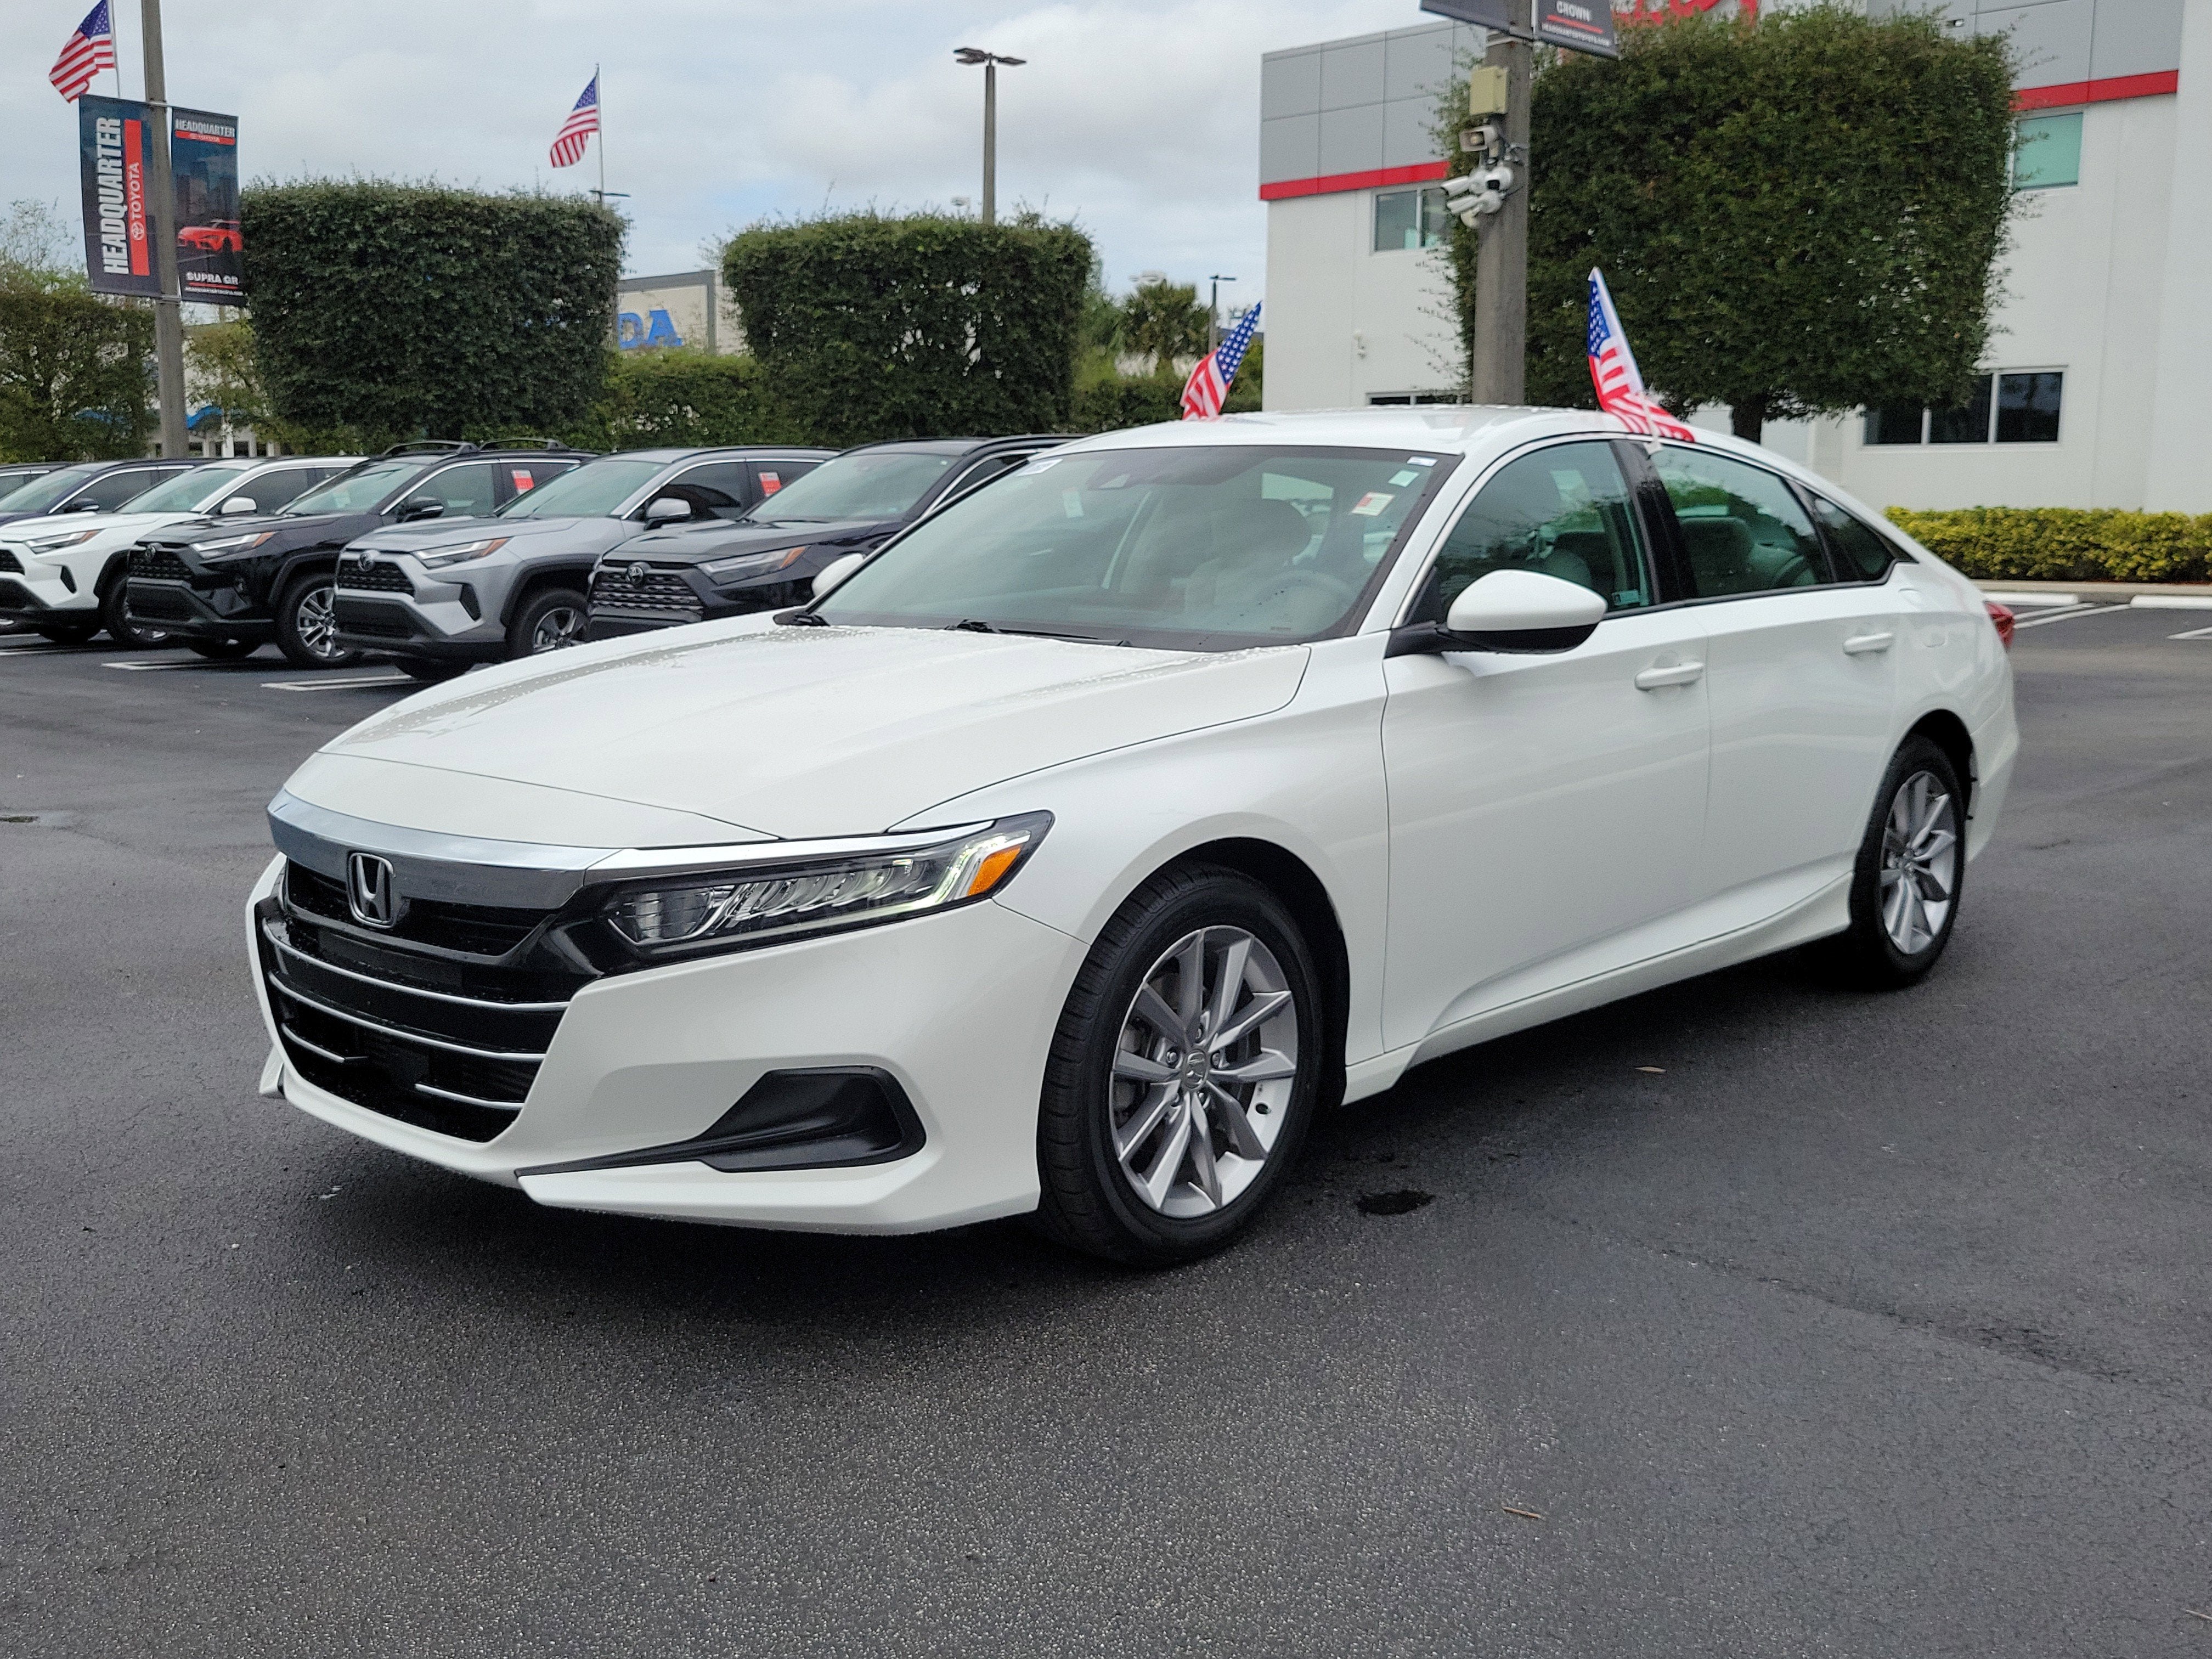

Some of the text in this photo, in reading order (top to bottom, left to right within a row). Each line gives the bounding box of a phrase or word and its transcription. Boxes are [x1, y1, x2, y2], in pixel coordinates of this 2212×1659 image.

[1556, 1, 1592, 22] CROWN
[176, 119, 235, 137] HEADQUARTER
[97, 117, 129, 274] HEADQUARTER
[129, 162, 142, 220] TOYOTA
[186, 271, 239, 285] SUPRA GR
